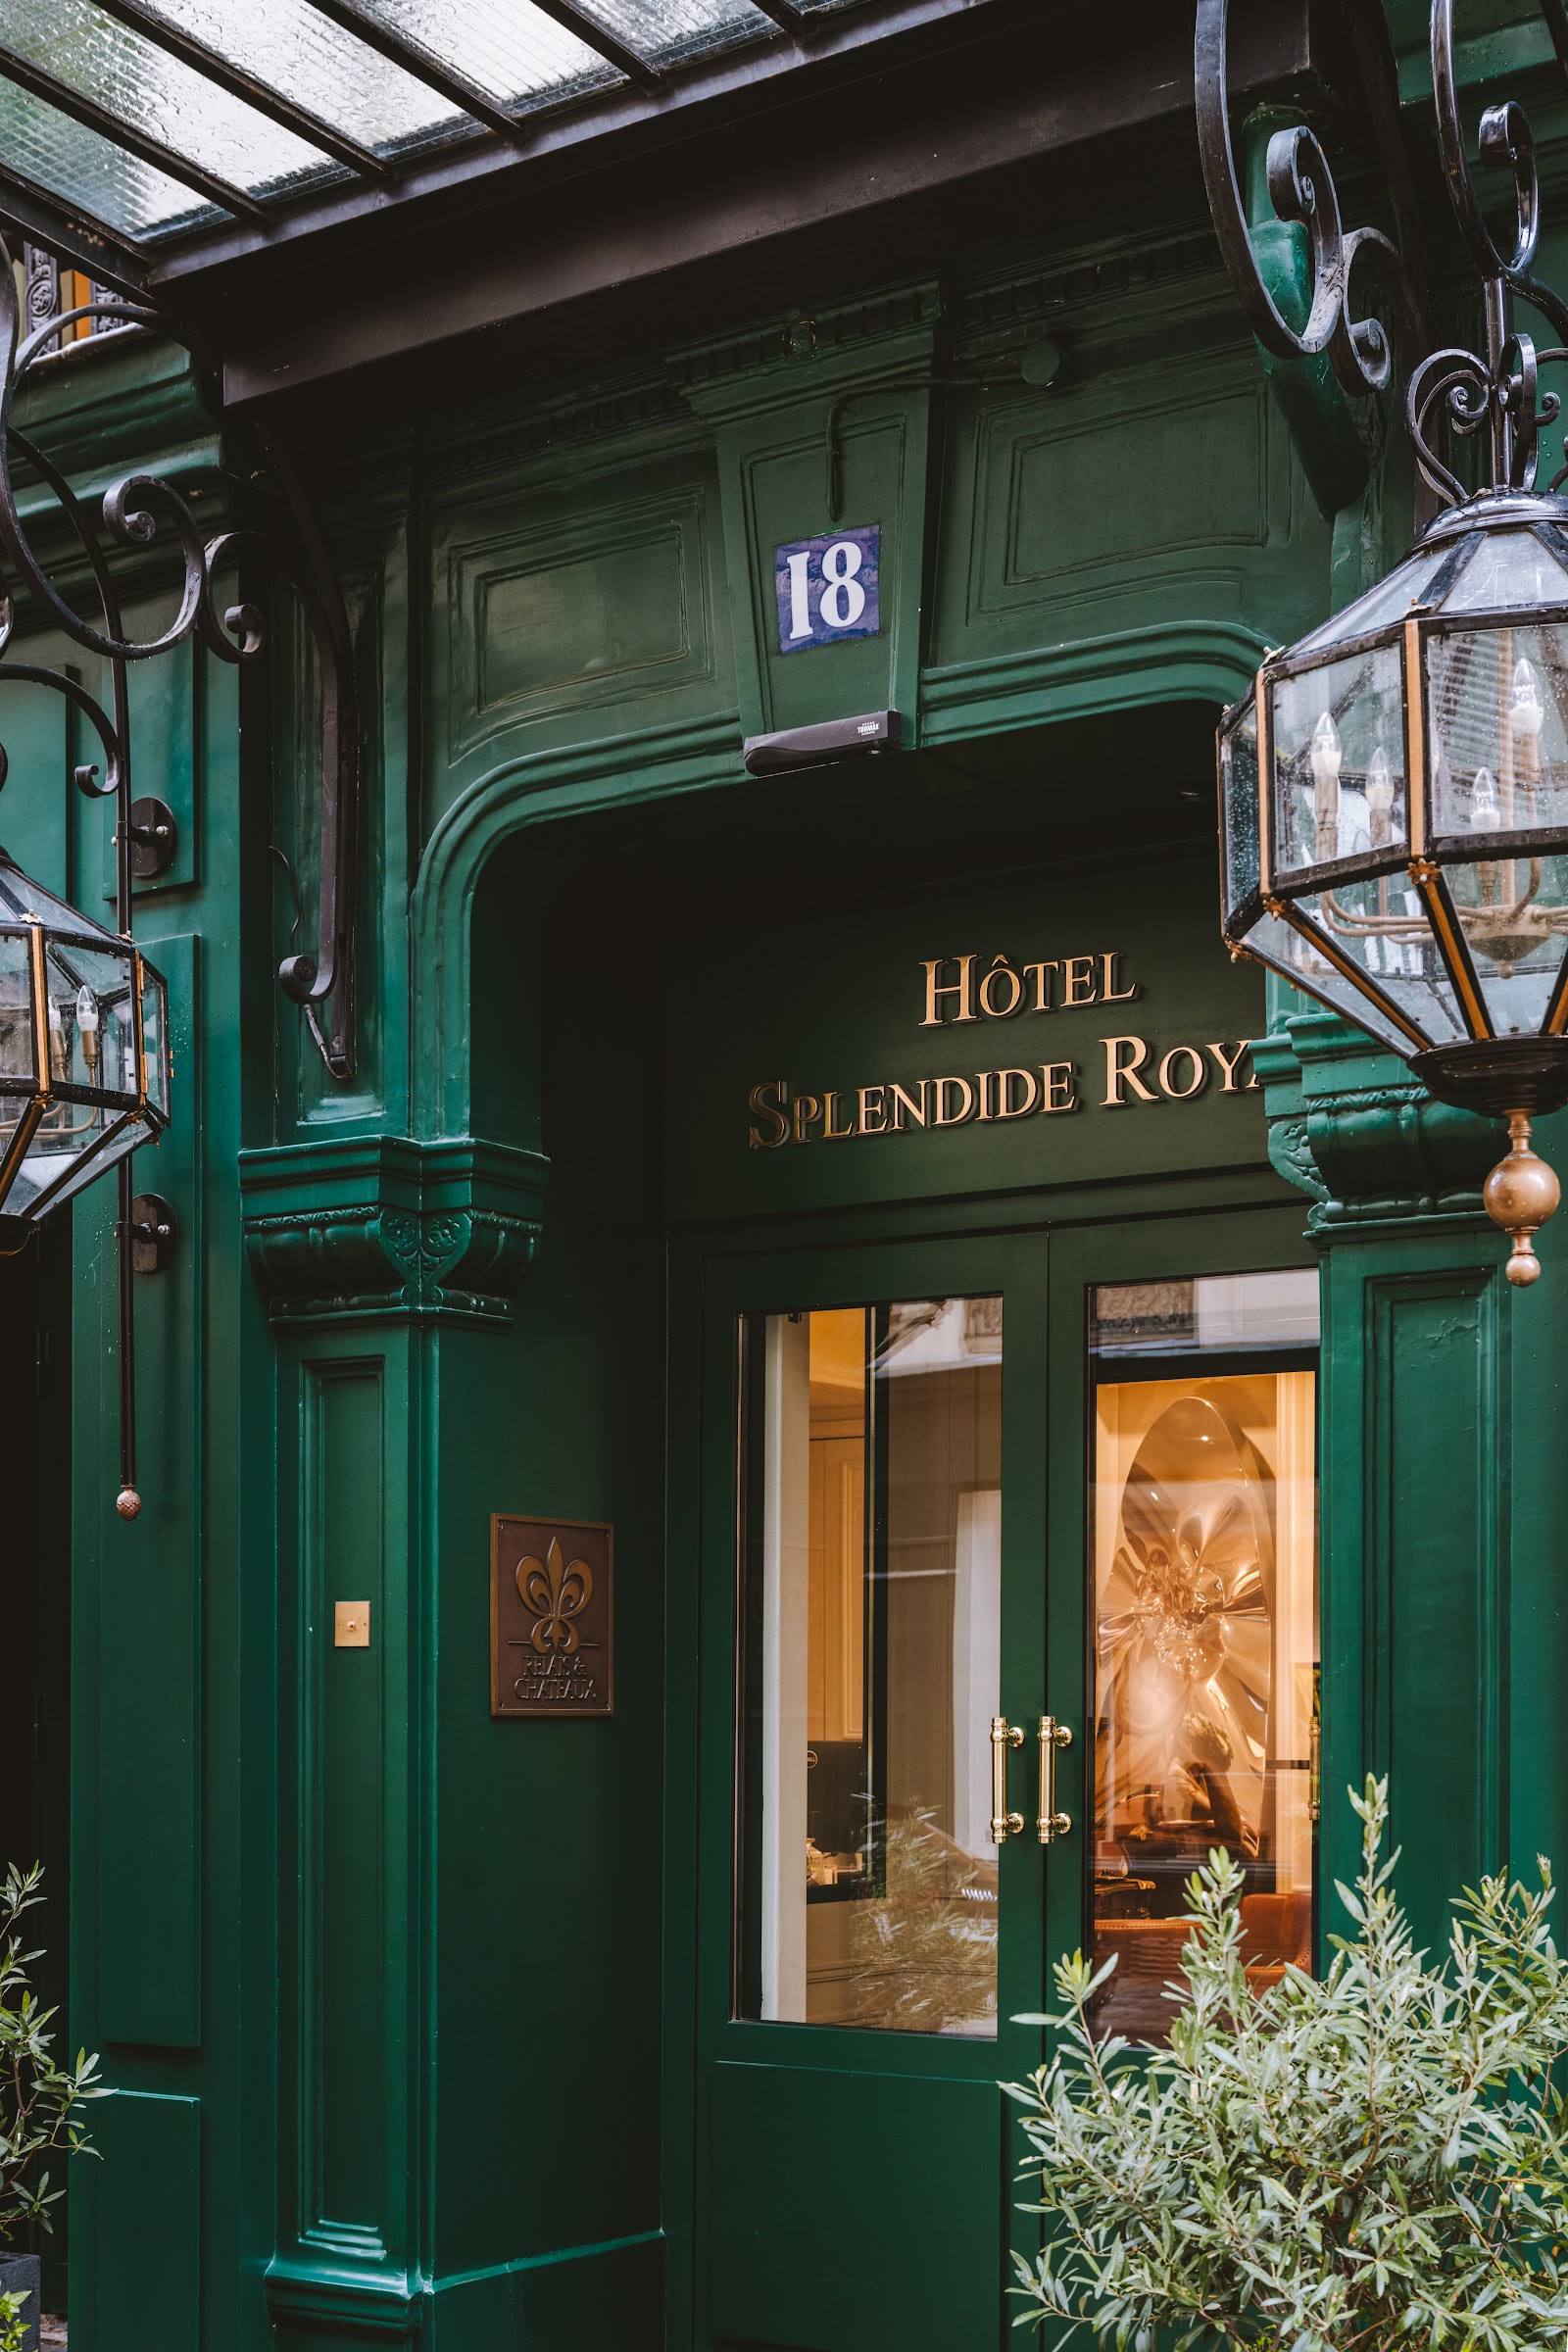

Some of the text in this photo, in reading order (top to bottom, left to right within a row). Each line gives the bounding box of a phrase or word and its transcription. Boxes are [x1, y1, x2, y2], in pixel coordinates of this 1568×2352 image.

[787, 541, 865, 640] 18
[917, 952, 1137, 1027] HÔTEL
[749, 1036, 1260, 1149] SPLENDIDE ROY
[523, 1654, 587, 1676] RELAIS &
